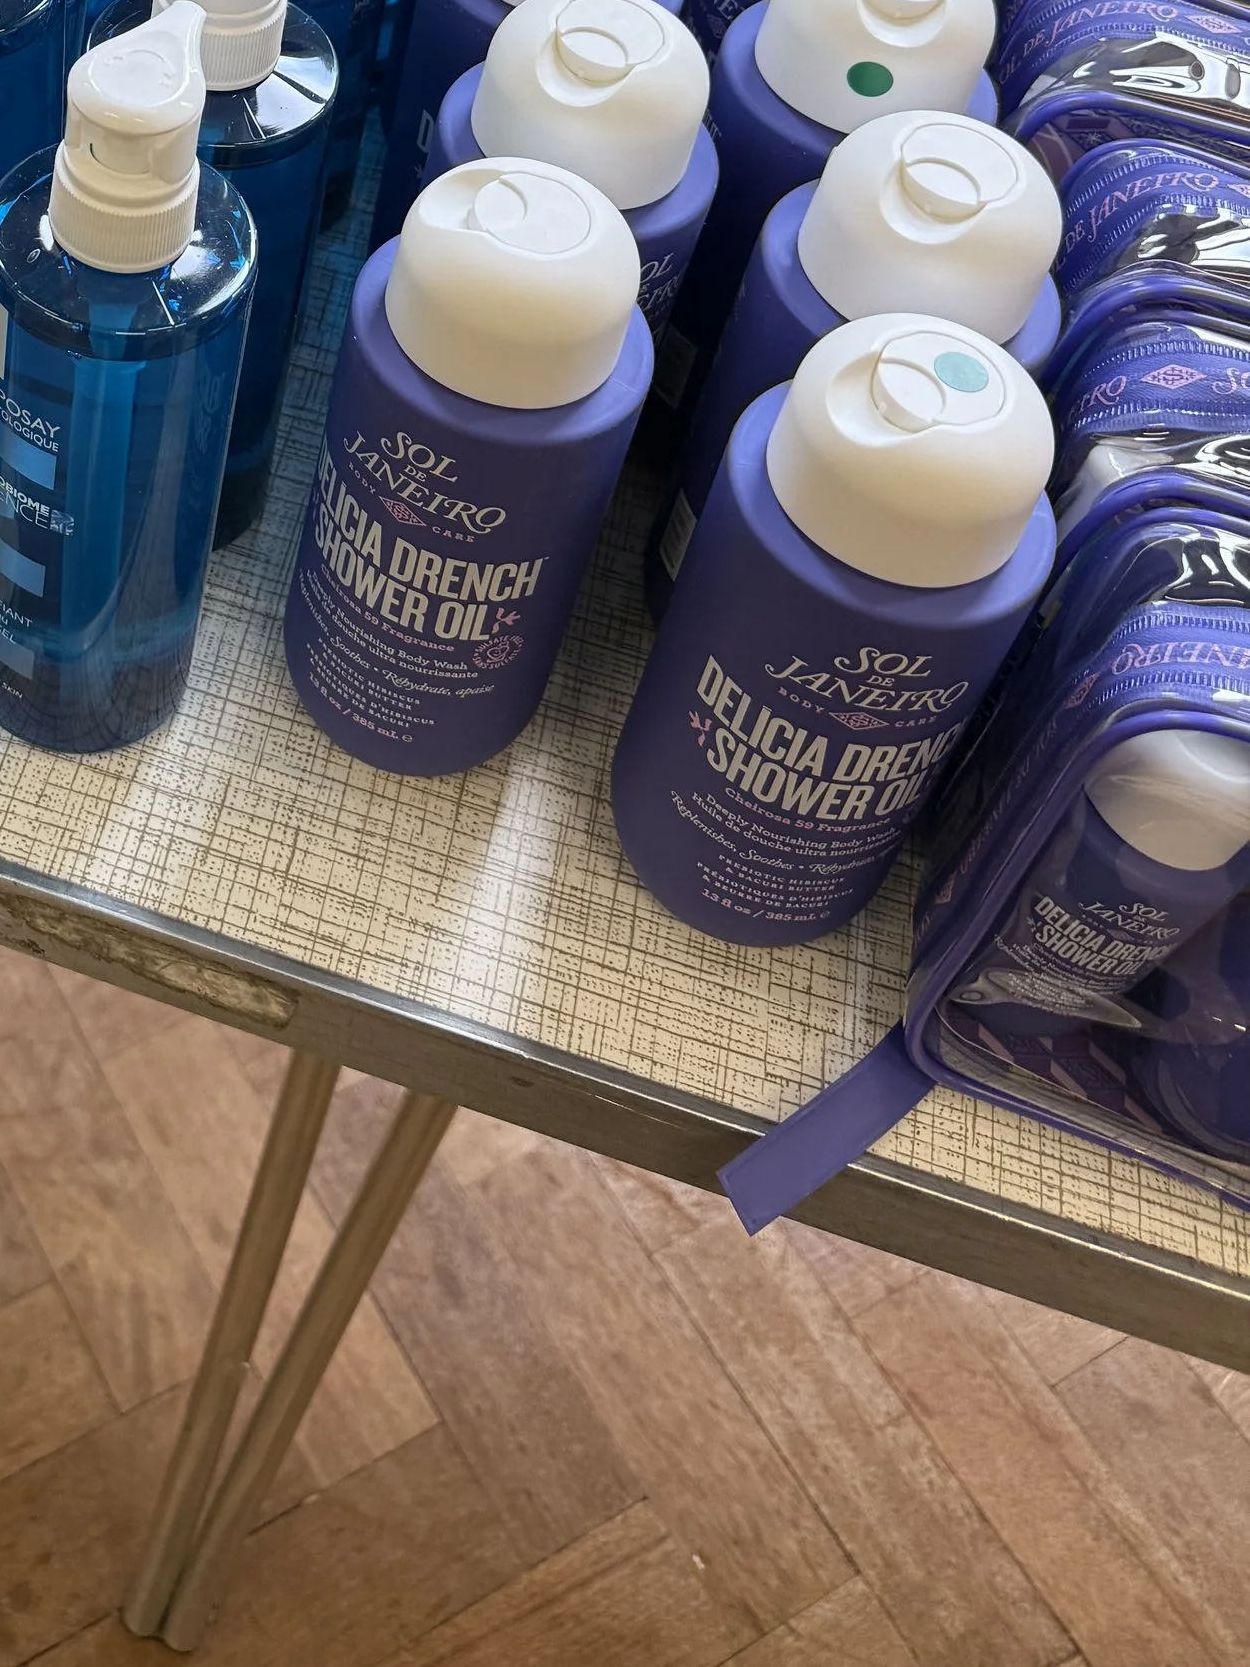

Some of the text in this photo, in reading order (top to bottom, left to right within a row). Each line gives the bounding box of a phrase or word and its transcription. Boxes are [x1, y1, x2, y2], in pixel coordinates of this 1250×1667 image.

[1000, 0, 1179, 84] OL DE JANEIRO
[1065, 171, 1220, 252] DE JANEIRO
[1068, 375, 1127, 422] EIRO
[380, 431, 458, 483] SOL
[403, 464, 427, 483] DE
[343, 430, 507, 535] JANEIRO
[348, 460, 475, 543] BODY CARE
[314, 504, 491, 641] SHOWER OIL
[389, 536, 544, 603] DRENCH
[321, 563, 362, 616] Cheirosa
[364, 612, 380, 625] 59
[381, 618, 455, 653] Fragrance
[331, 613, 367, 649] douche
[368, 643, 397, 664] ultra
[398, 659, 479, 679] nourrissante
[336, 606, 395, 656] Nourishing
[398, 648, 432, 667] Body
[433, 659, 468, 671] Wash
[834, 646, 933, 677] SOL
[1112, 641, 1250, 676] NEIRO
[1, 682, 24, 699] SKIN
[330, 635, 496, 698] Soothes Réhydrate, apaise
[764, 655, 970, 713] JANEIRO
[866, 674, 895, 687] DE
[352, 698, 411, 729] DE BACURI
[368, 679, 421, 705] HIBISCUS
[368, 688, 413, 711] BUTTER
[778, 686, 938, 728] BODY CARE
[329, 696, 399, 740] oz 385 mL
[706, 727, 875, 821] SHOWER
[875, 769, 928, 817] OIL
[833, 719, 965, 783] DRENC
[670, 790, 796, 872] Replenishes, Soothes
[691, 791, 827, 858] Huile de douche ultra
[705, 792, 750, 828] Deeply
[751, 823, 828, 850] Nourishing
[830, 837, 864, 850] Body
[725, 787, 891, 834] Cheirosa 59 Fragrance
[718, 853, 786, 883] PREBIOTIC
[737, 870, 836, 893] BACURI BUTTER
[701, 888, 817, 922] 13 fl oz 385 mL
[714, 880, 762, 904] BEURRE
[765, 898, 781, 908] DE
[1118, 901, 1170, 923] SOL
[1078, 901, 1181, 940] JANEIRO
[1035, 924, 1143, 976] SHOWER OIL
